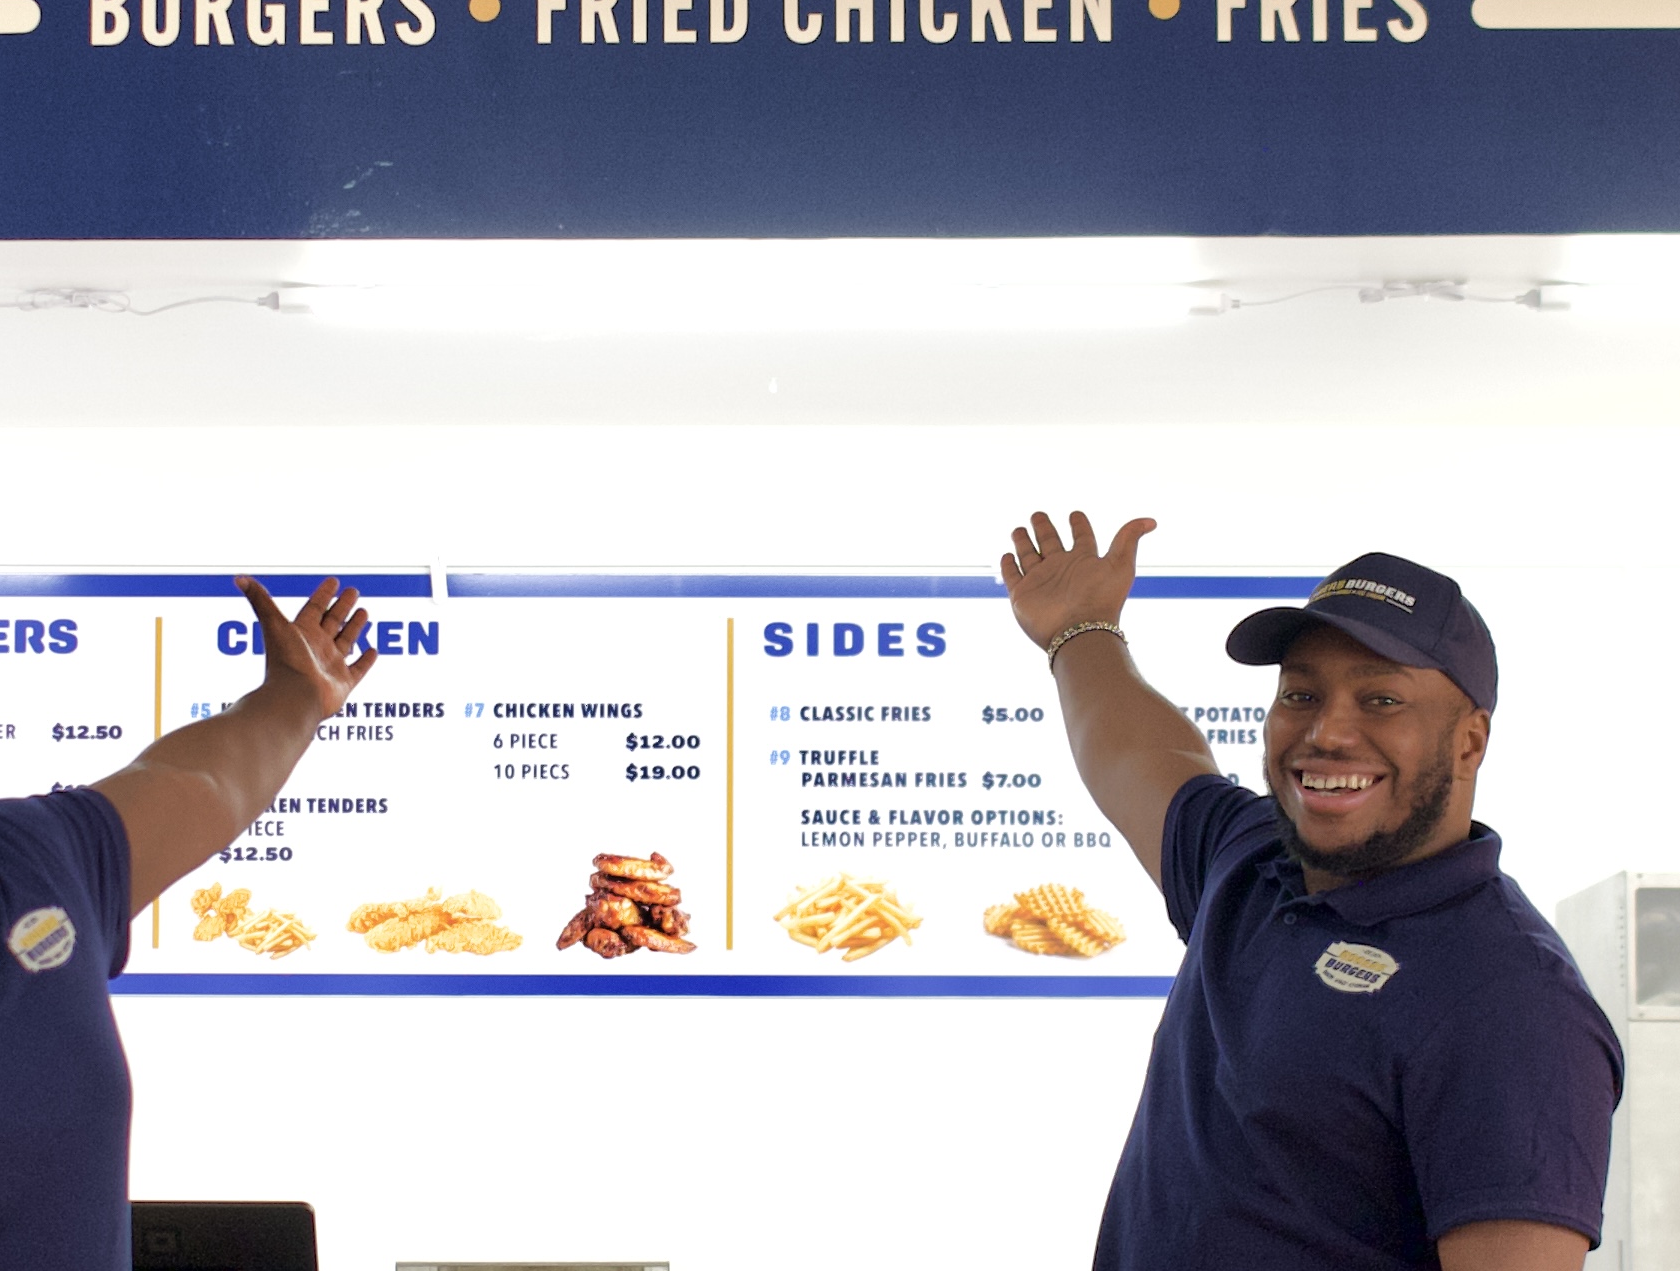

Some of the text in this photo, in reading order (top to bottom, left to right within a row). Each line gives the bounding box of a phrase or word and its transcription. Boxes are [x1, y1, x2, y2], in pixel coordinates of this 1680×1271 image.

[1345, 578, 1416, 607] BURGERS
[217, 620, 439, 656] CKEN
[763, 621, 947, 658] SIDES
[190, 703, 211, 719] #5
[364, 702, 445, 718] TENDERS
[464, 702, 643, 719] #7 CHICKEN WINGS
[769, 705, 1044, 725] #8 CLASSIC FRIES $5.00
[1194, 706, 1266, 722] POTATO
[51, 722, 123, 743] $12.50
[346, 725, 394, 741] FRIES
[1206, 729, 1258, 745] FRIES
[492, 731, 701, 752] 6 PIECE $12.00
[769, 749, 880, 766] #9 TRUFFLE
[493, 762, 701, 783] 10 PIECS $19.00
[801, 770, 1042, 791] PARMESAN FRIES $7.00
[307, 798, 389, 814] TENDERS
[800, 809, 1064, 826] SAUCE & FLAVOR OPTIONS:
[248, 820, 286, 837] IECE
[801, 831, 1112, 850] LEMON PEPPER, BUFFALO OR BBQ
[220, 846, 294, 864] $12.50
